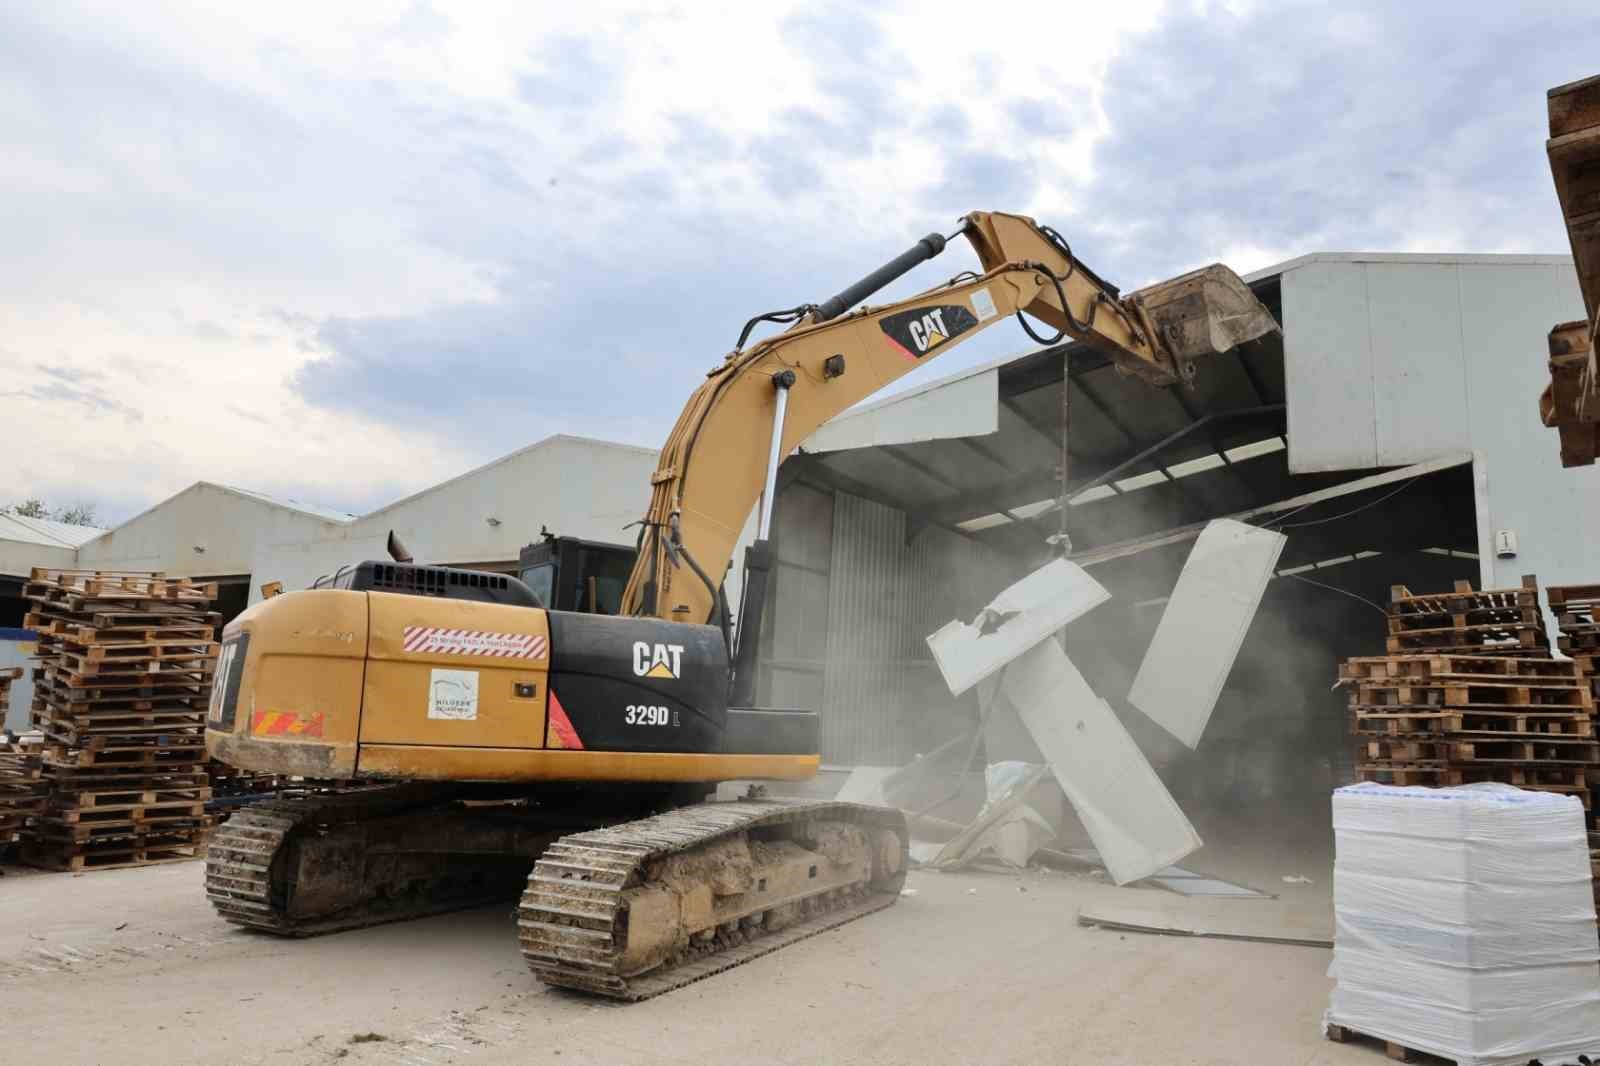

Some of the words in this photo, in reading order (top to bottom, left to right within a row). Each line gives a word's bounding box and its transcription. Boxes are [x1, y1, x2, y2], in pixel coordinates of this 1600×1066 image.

[908, 308, 950, 351] CAT
[632, 641, 685, 679] CAT
[625, 704, 669, 726] 329D
